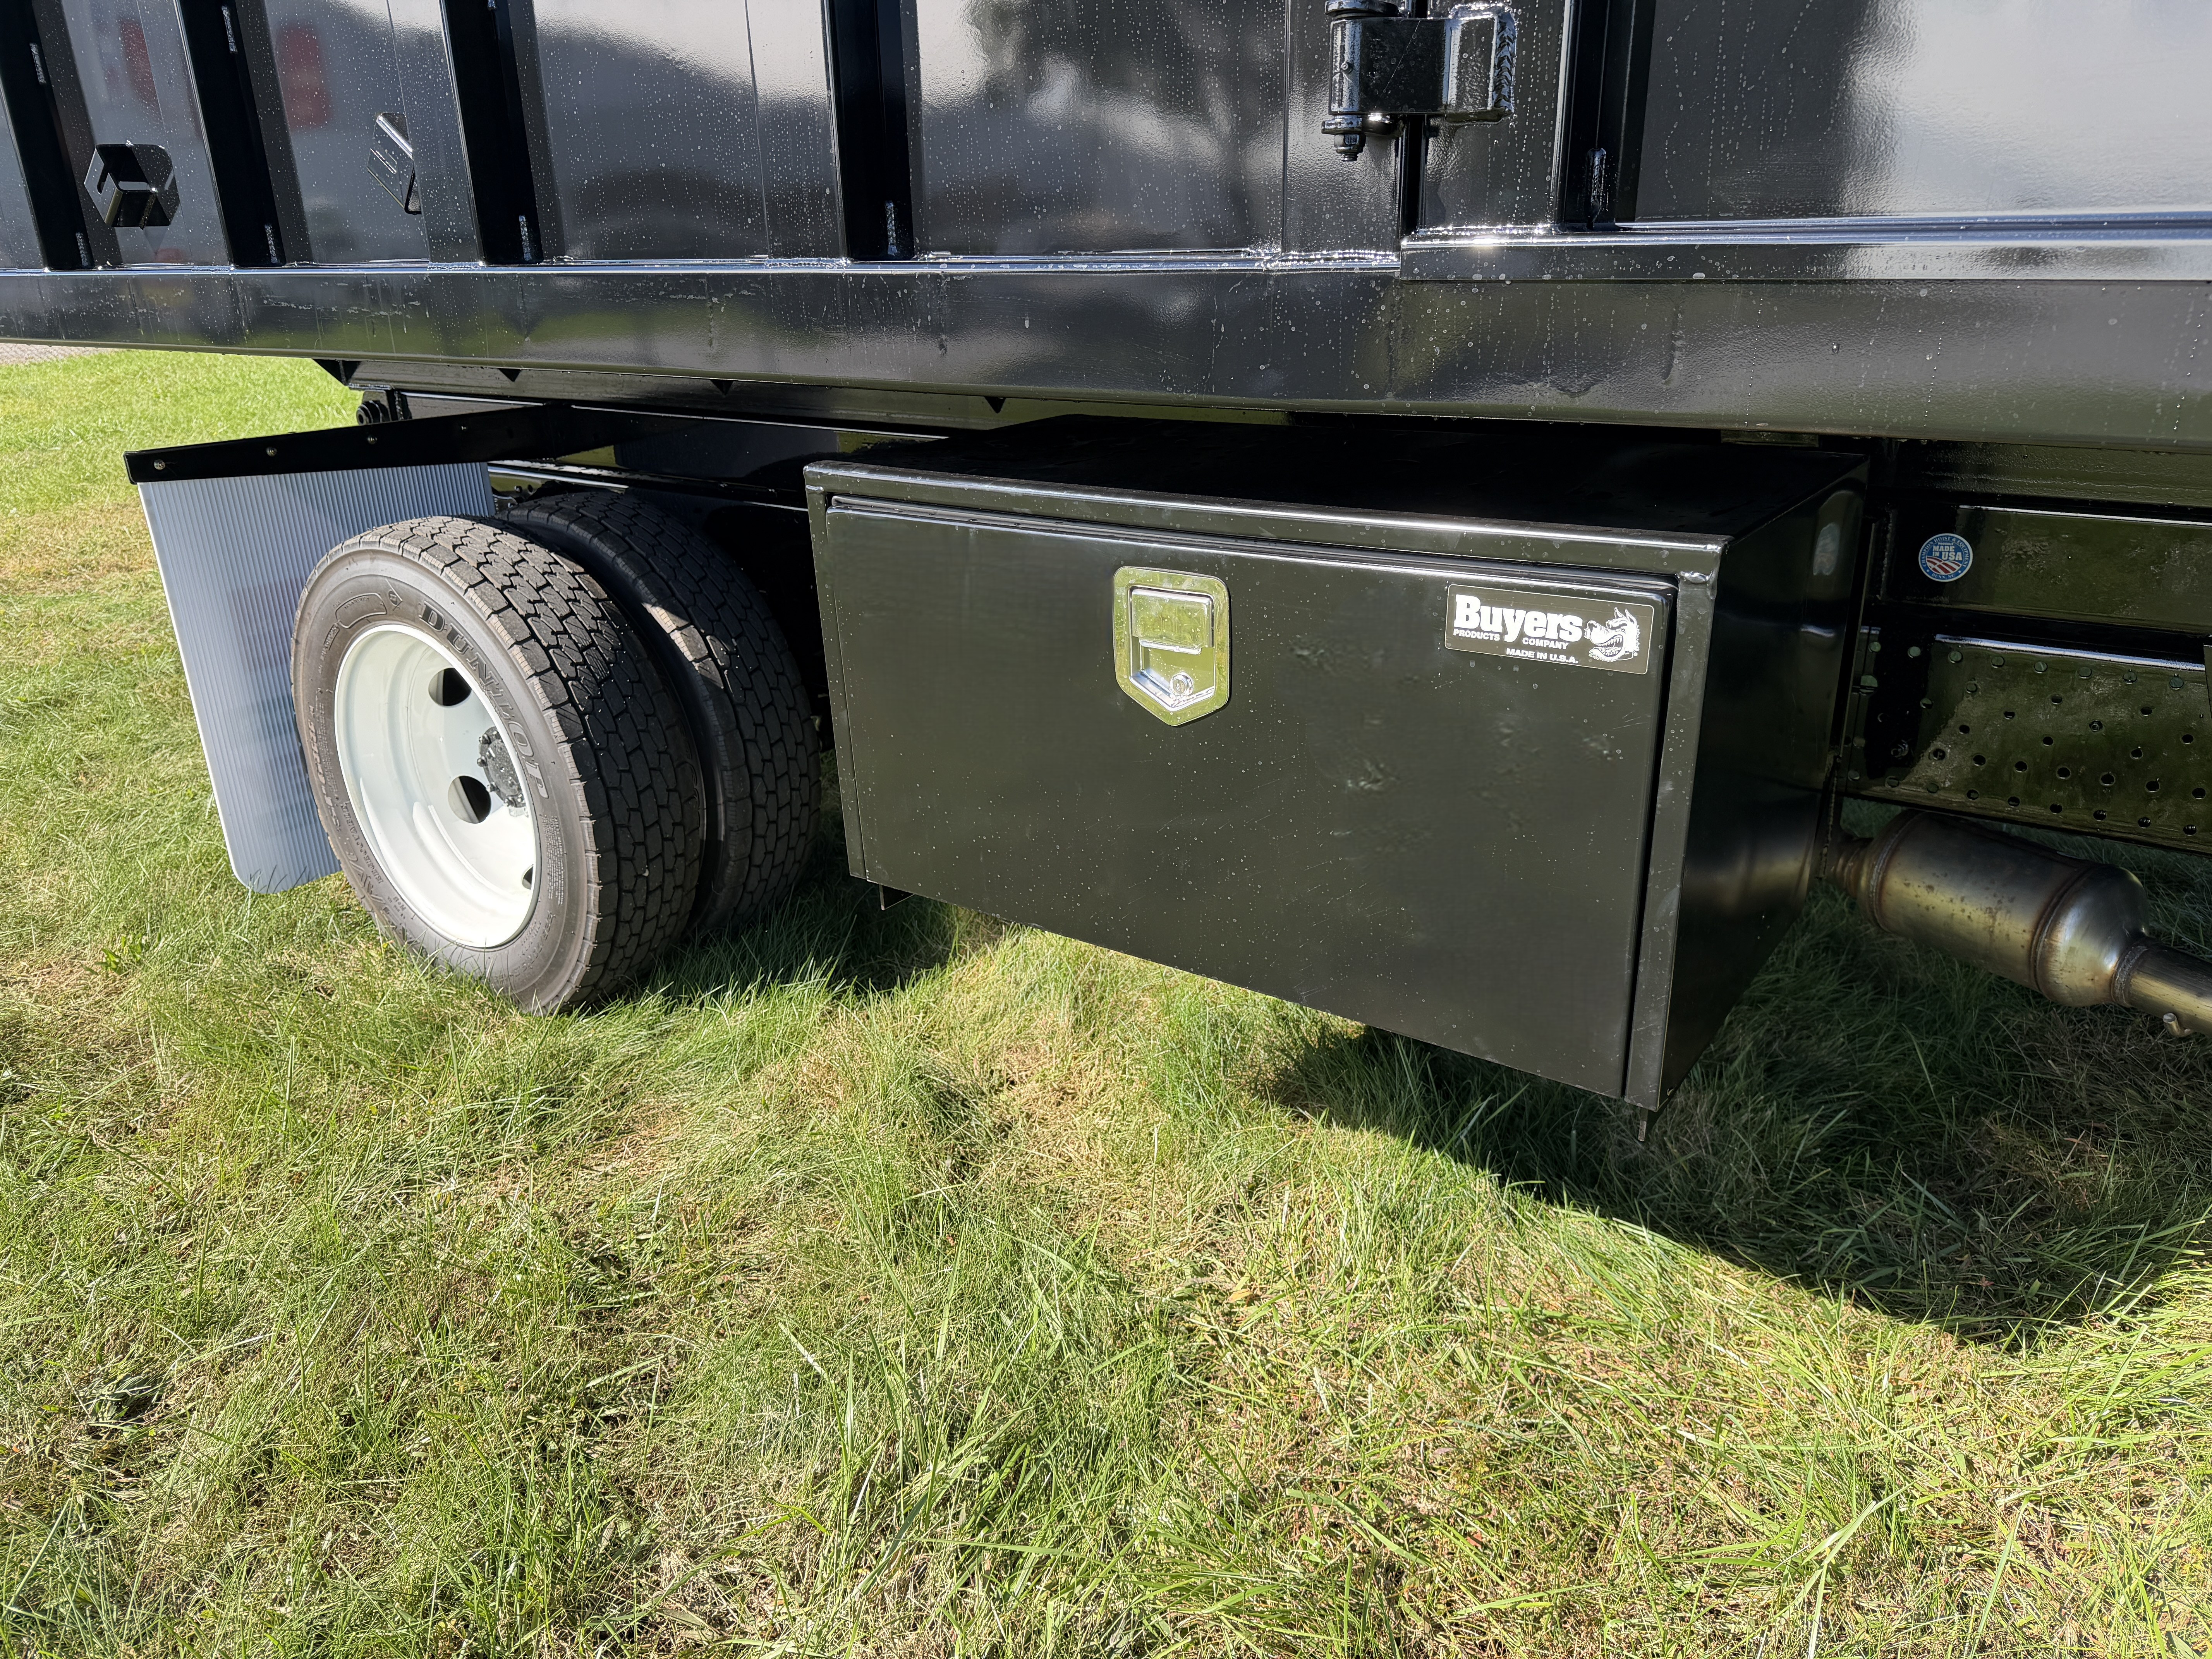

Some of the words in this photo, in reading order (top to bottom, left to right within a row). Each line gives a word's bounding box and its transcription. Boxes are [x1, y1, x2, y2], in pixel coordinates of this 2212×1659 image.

[1922, 541, 1934, 567] CHAMPION
[1957, 539, 1968, 567] EQUIPMENT
[1941, 552, 1963, 561] USA
[1454, 594, 1583, 642] Buyers
[1453, 629, 1501, 641] PRODUCTS
[1522, 637, 1569, 650] COMPANY
[1506, 648, 1535, 659] MADE
[1536, 651, 1547, 659] IN
[1549, 653, 1578, 663] U.S.A.
[419, 600, 549, 799] DUNLOP
